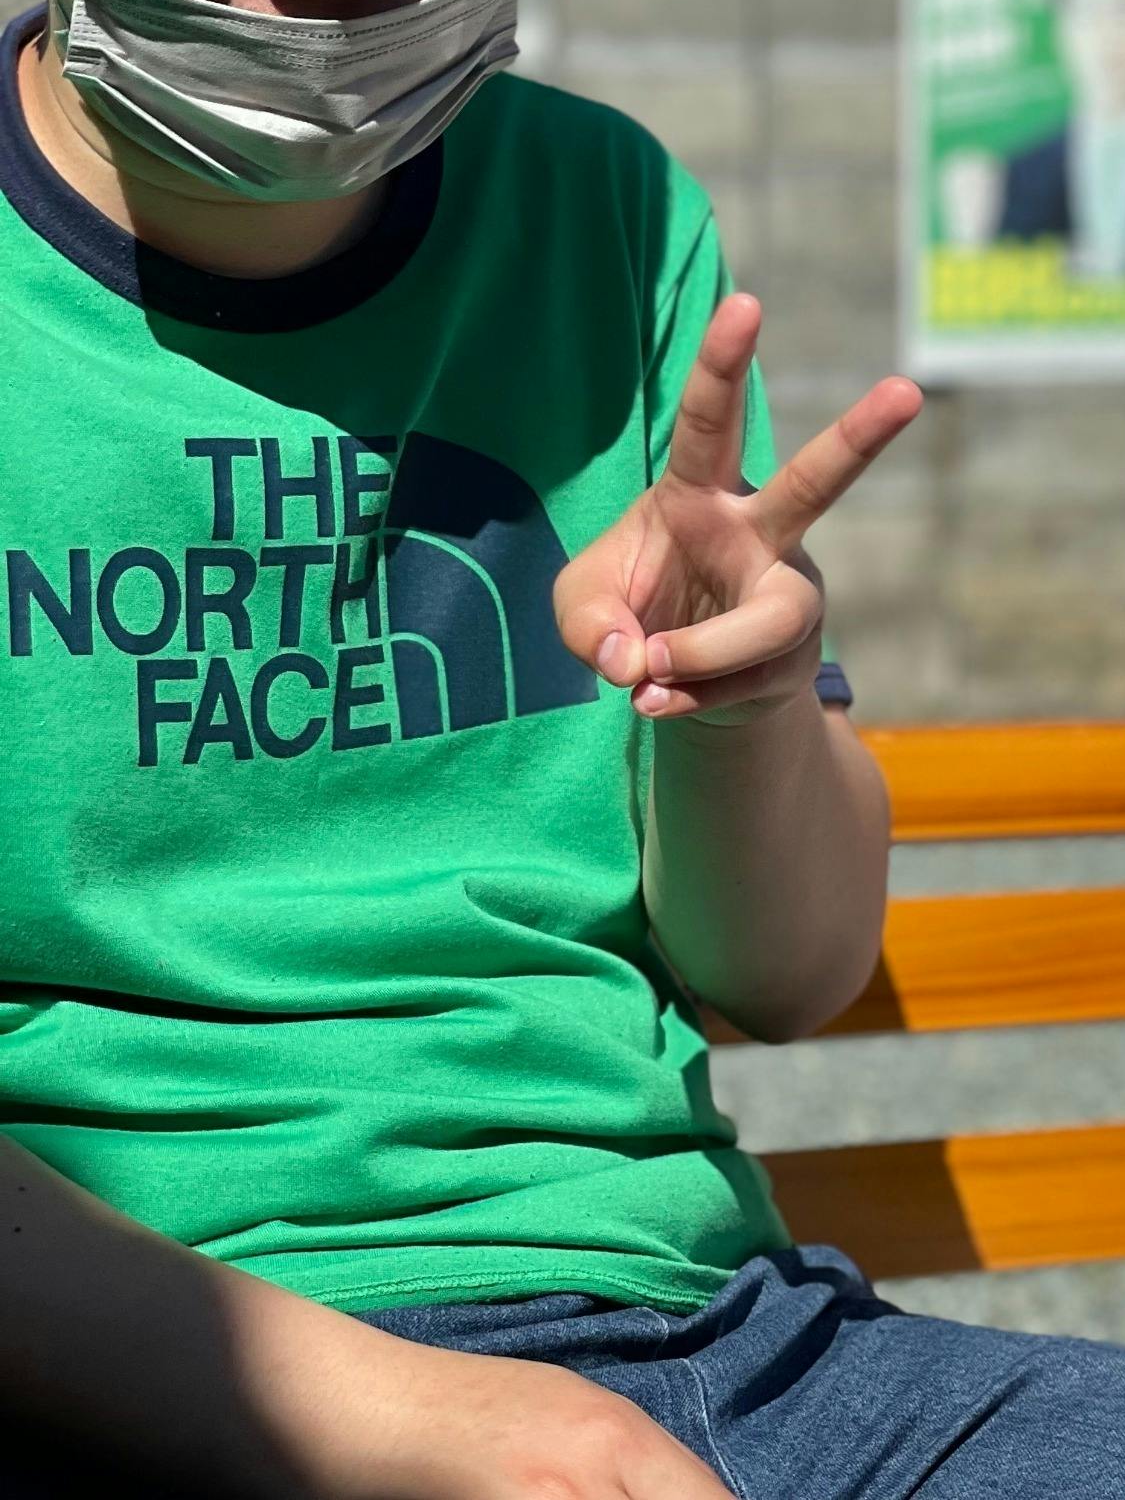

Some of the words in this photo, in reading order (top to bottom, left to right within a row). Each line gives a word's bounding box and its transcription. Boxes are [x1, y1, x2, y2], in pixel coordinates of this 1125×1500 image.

[185, 435, 398, 541] THE
[5, 536, 384, 657] NORTH
[136, 643, 392, 768] FACE
